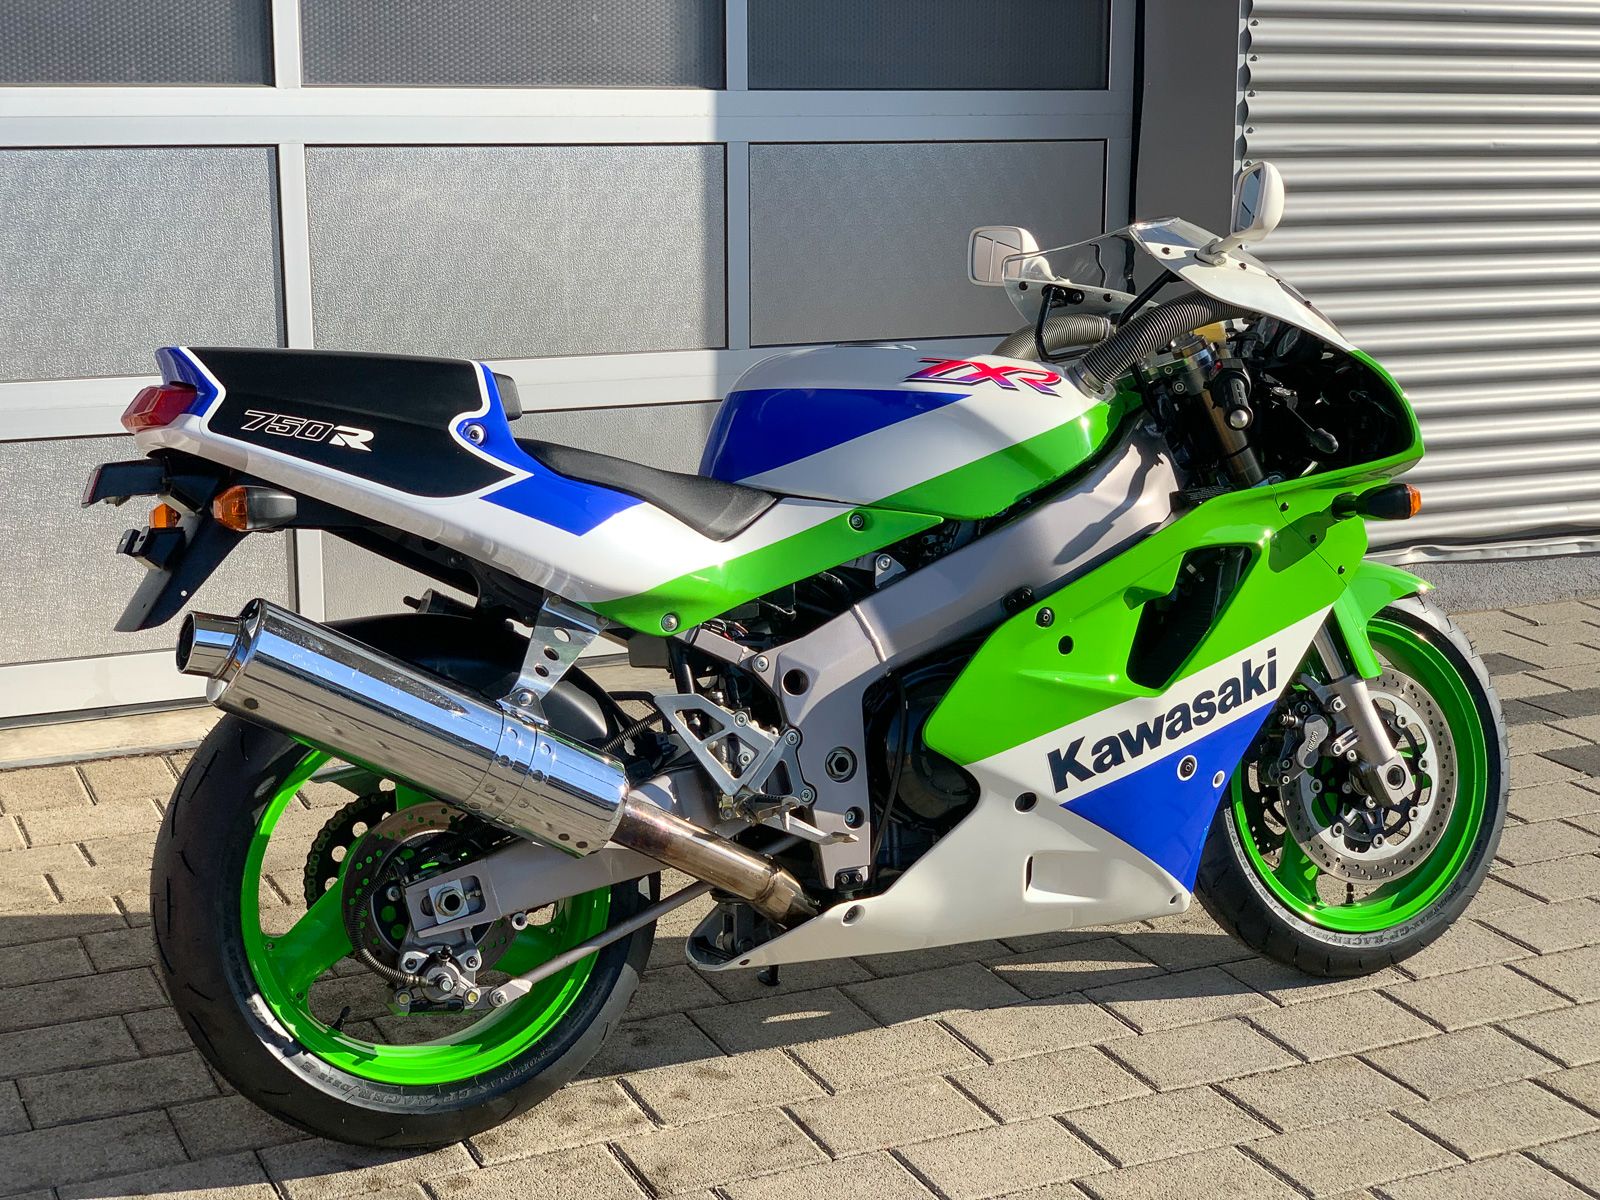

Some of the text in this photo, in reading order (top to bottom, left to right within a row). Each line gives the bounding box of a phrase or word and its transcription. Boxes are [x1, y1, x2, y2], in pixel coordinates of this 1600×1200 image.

[903, 357, 1062, 398] ZXR
[240, 409, 375, 452] 750R
[1047, 647, 1277, 794] Kawasaki
